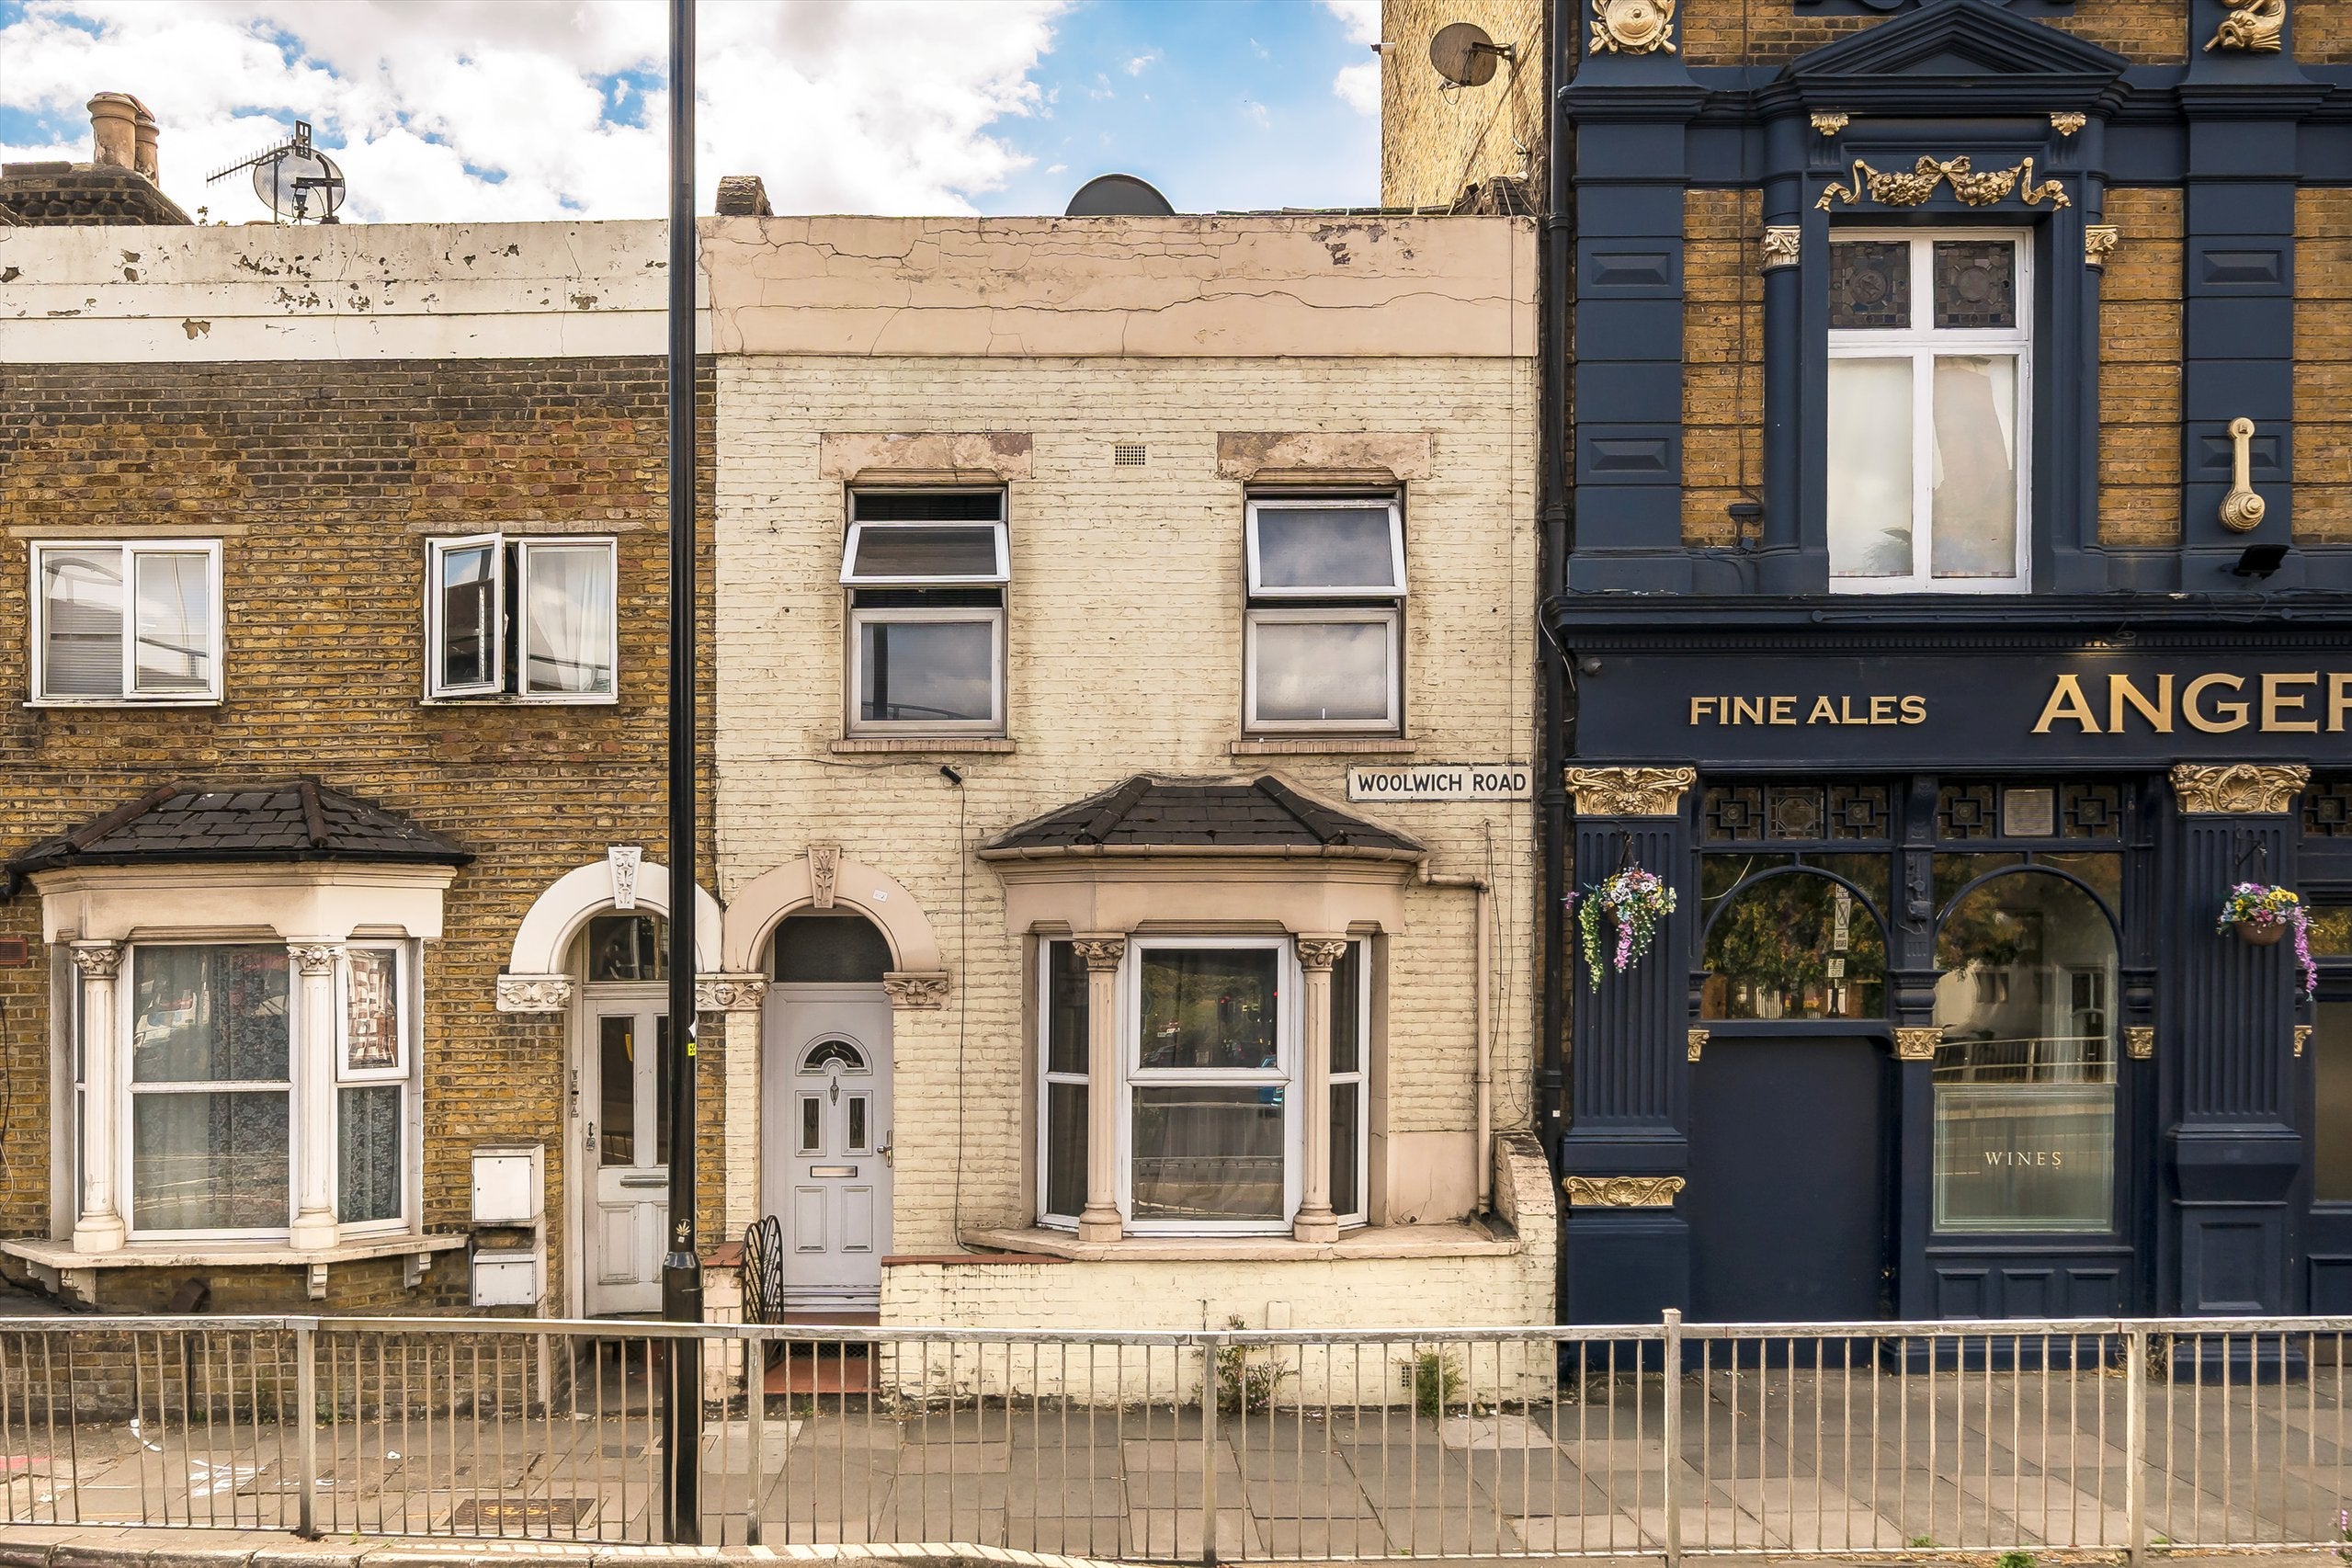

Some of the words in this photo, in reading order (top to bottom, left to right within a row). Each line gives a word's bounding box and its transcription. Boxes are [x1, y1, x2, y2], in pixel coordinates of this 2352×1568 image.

[1689, 695, 1798, 725] FINE
[1806, 695, 1927, 725] ALES
[1358, 774, 1462, 791] WOOLWICH
[1473, 773, 1527, 791] ROAD
[1984, 1151, 2062, 1166] WINES
